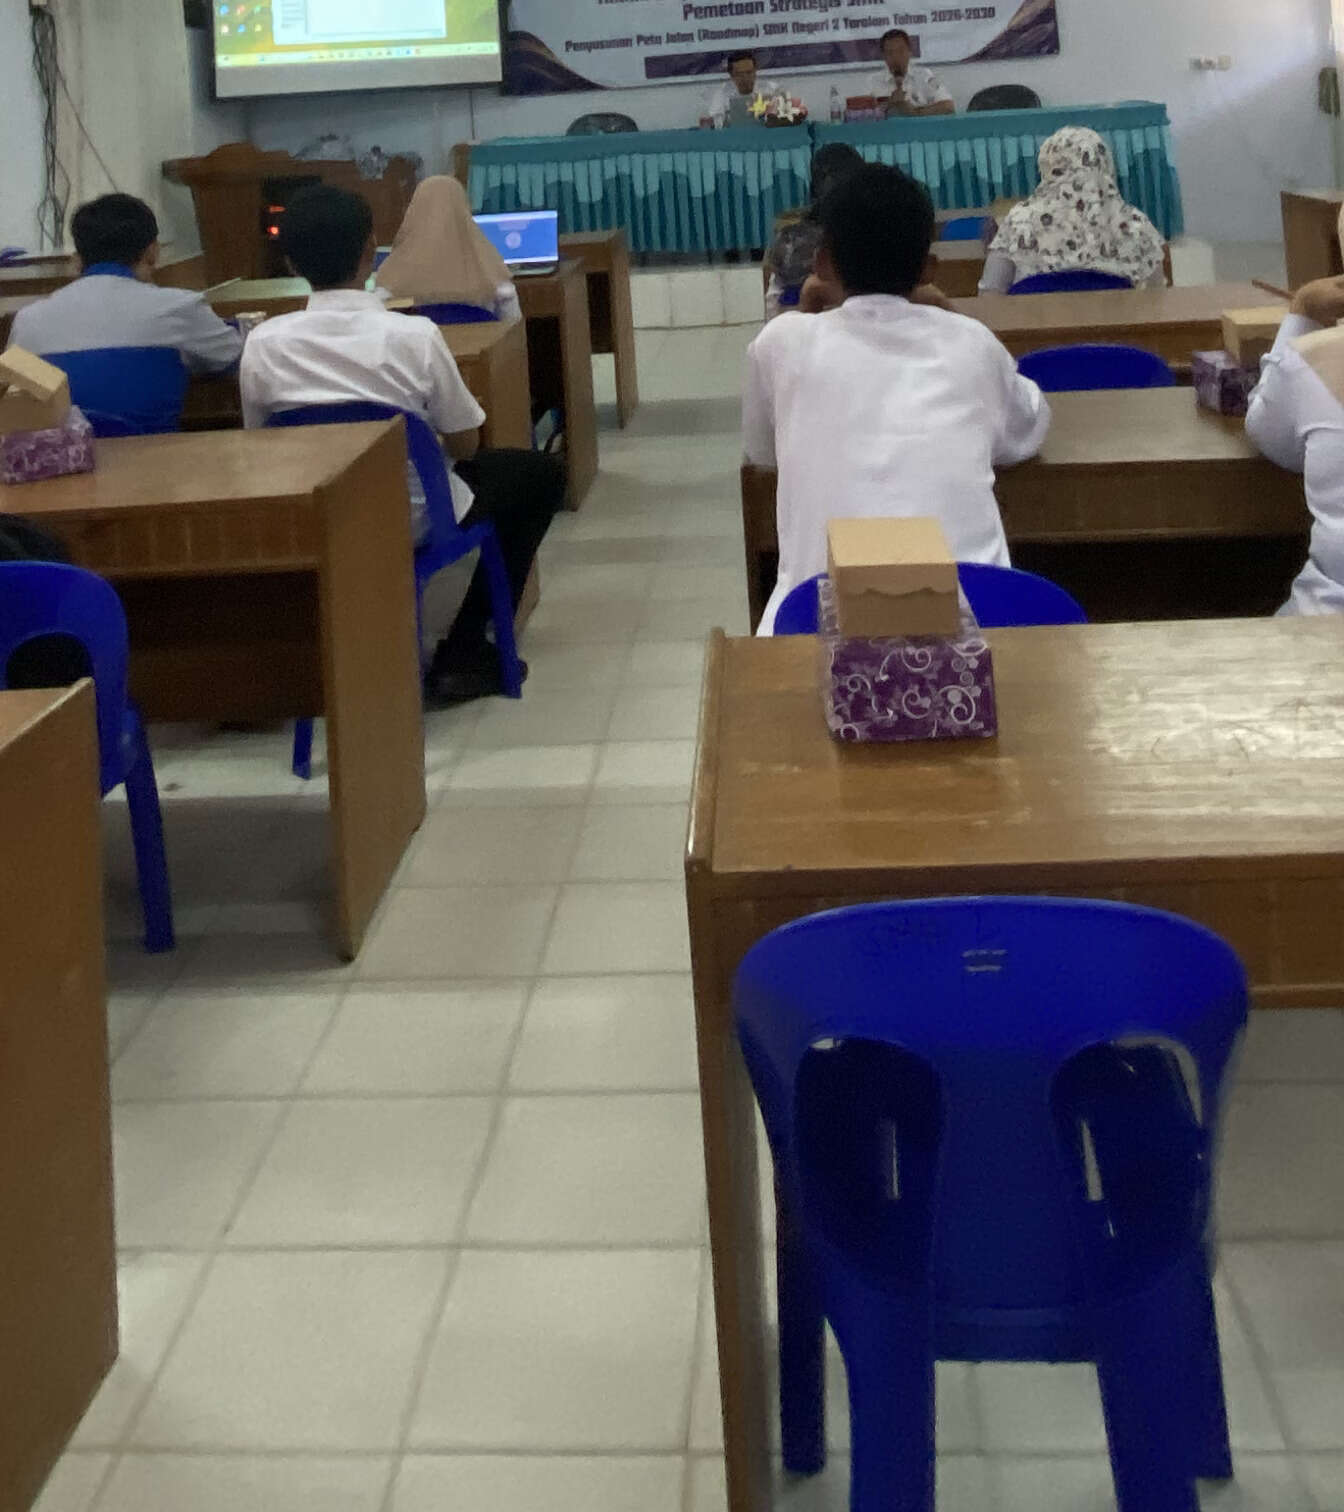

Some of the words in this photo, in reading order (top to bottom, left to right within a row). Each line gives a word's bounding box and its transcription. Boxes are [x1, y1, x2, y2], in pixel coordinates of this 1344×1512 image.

[682, 0, 765, 21] Pemetaan
[564, 37, 633, 53] Penyusunan
[636, 33, 662, 47] Peta
[665, 31, 695, 44] Jalan
[792, 18, 829, 35] Negeri
[832, 17, 840, 31] 2
[893, 12, 928, 26] Tahun
